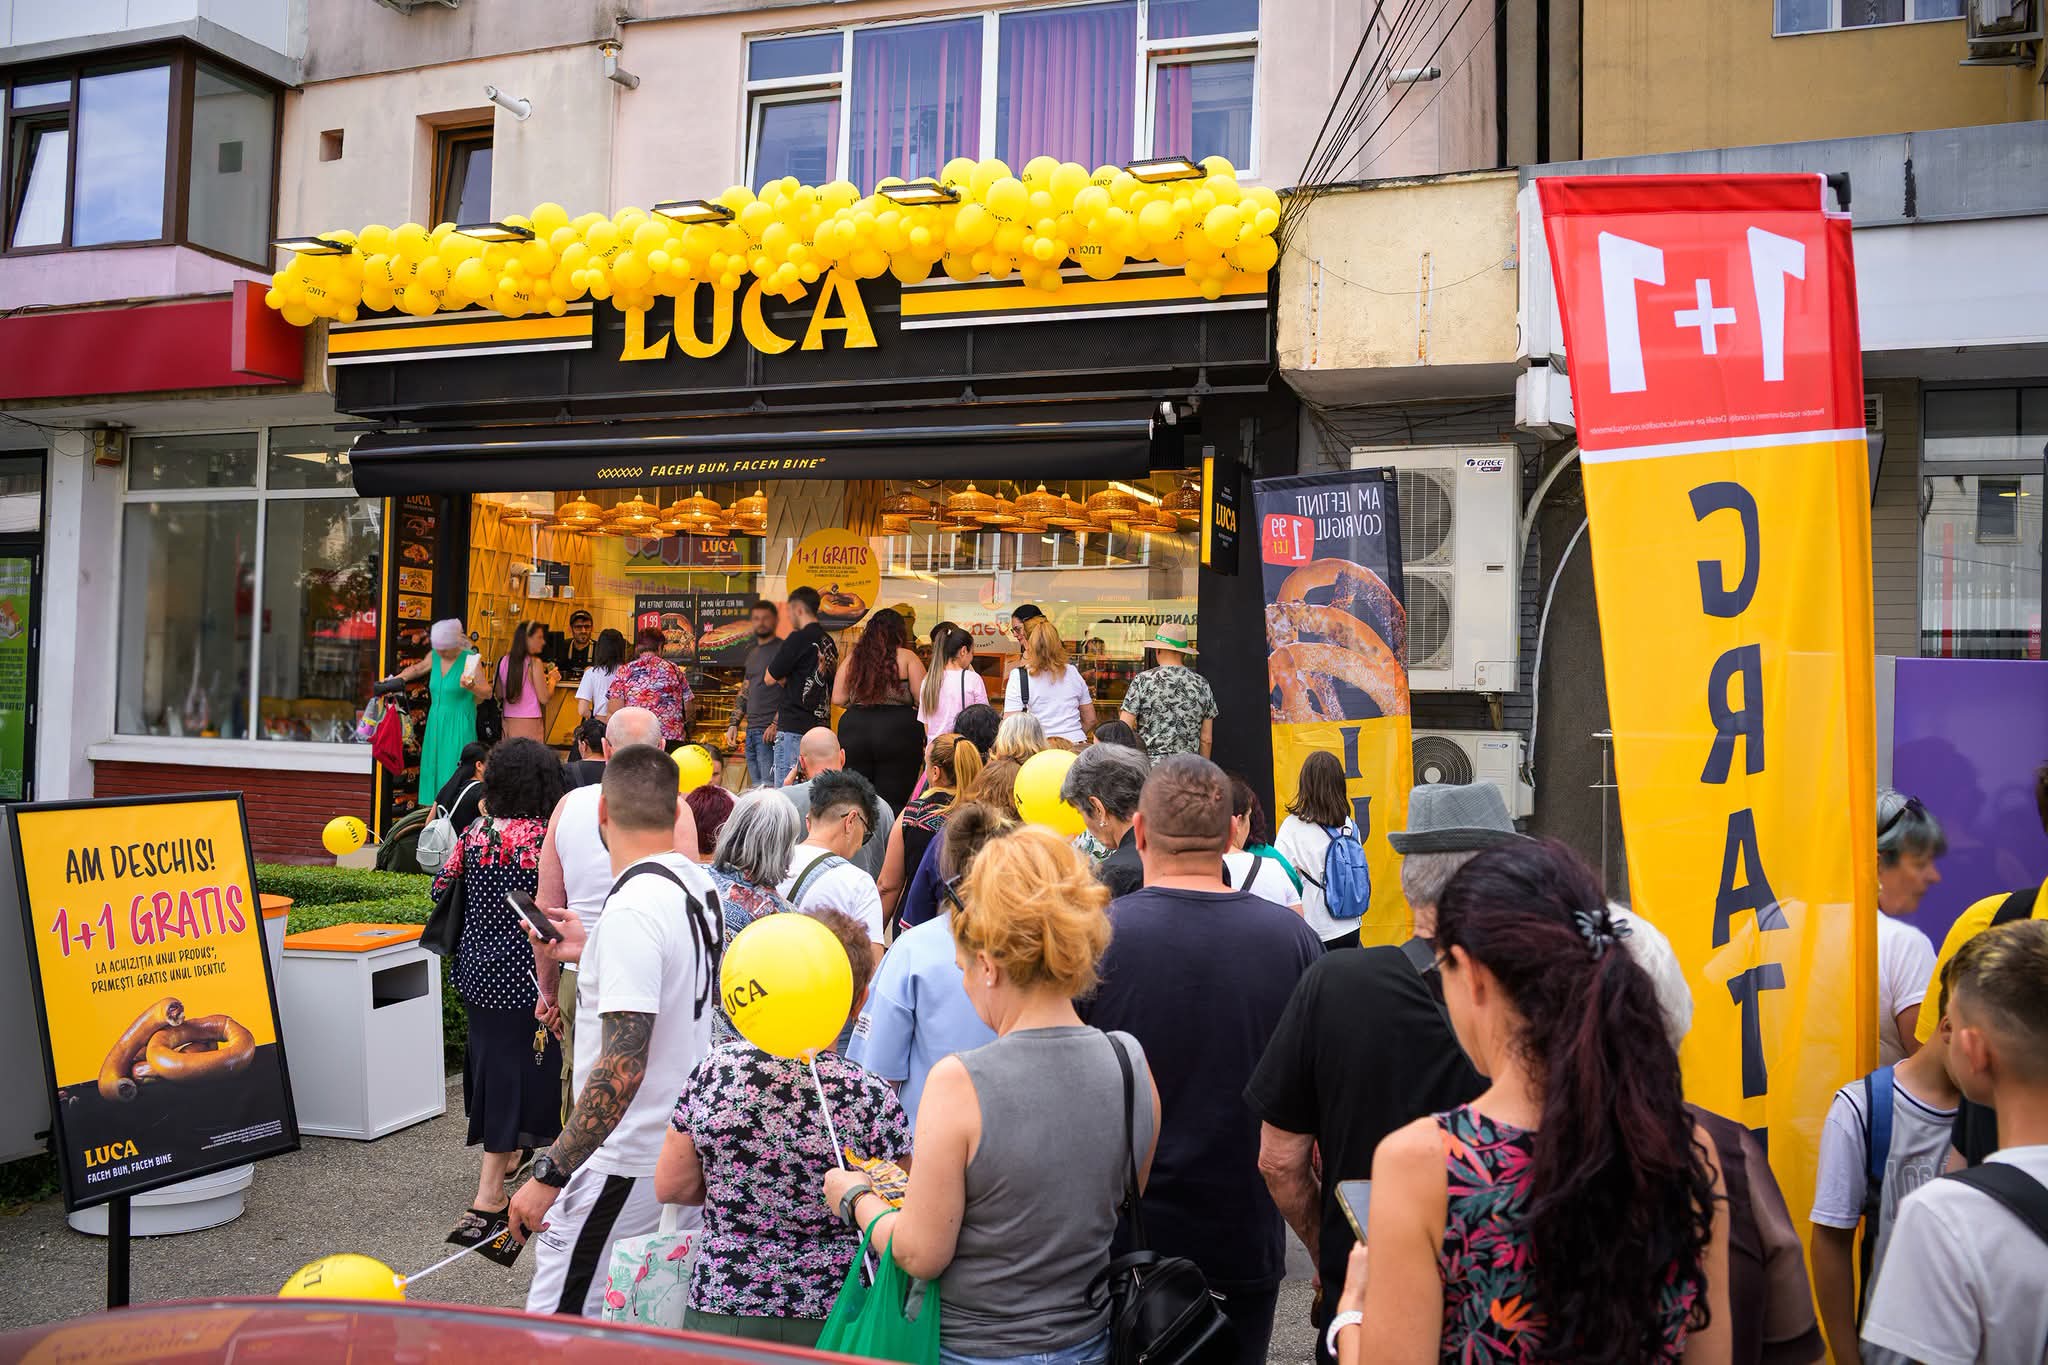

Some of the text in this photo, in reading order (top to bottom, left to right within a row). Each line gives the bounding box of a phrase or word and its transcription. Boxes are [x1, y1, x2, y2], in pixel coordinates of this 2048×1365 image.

[619, 269, 878, 361] LUCA
[650, 464, 694, 477] FACEM
[697, 461, 730, 474] BUN,
[733, 459, 779, 472] FACEM
[1476, 459, 1504, 467] GREE
[1215, 502, 1237, 533] LUCA
[701, 540, 738, 552] LUCA
[822, 546, 868, 566] GRATIS
[66, 838, 216, 885] AM DESCHIS!
[51, 884, 247, 957] 1+1 GRATIS
[96, 962, 107, 975] LA
[156, 951, 177, 965] UNUI
[137, 970, 168, 986] GRATIS
[169, 967, 193, 981] UNUL
[194, 961, 227, 977] IDENTIC
[724, 978, 768, 1016] UCA
[84, 1139, 140, 1168] LUCA
[87, 1153, 174, 1184] FACEM BUN, FACEM BINE
